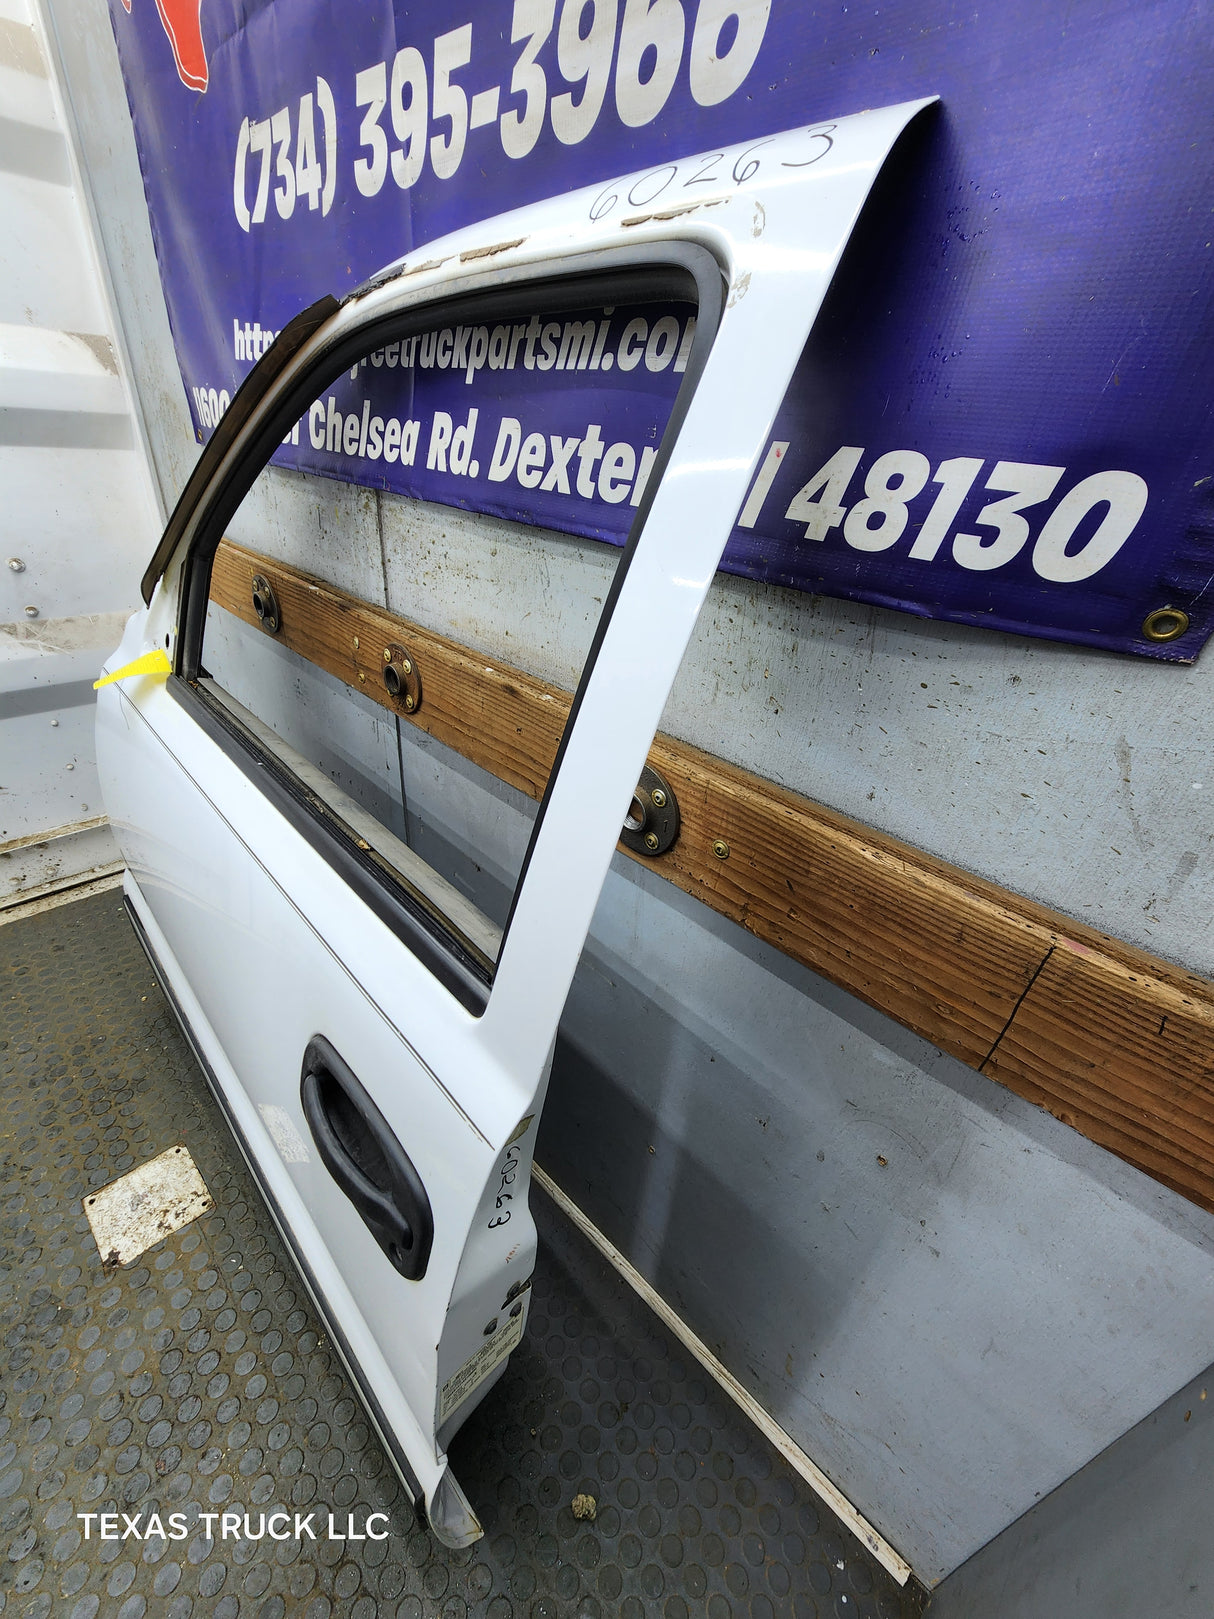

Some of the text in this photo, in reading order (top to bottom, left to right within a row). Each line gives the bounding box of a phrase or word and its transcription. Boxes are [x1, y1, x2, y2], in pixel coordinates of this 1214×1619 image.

[233, 76, 337, 232] (734)
[589, 124, 838, 224] 60263
[308, 397, 421, 466] Chelsea
[428, 408, 480, 478] Rd.
[487, 417, 660, 508] Dexter
[784, 445, 1149, 583] 48130
